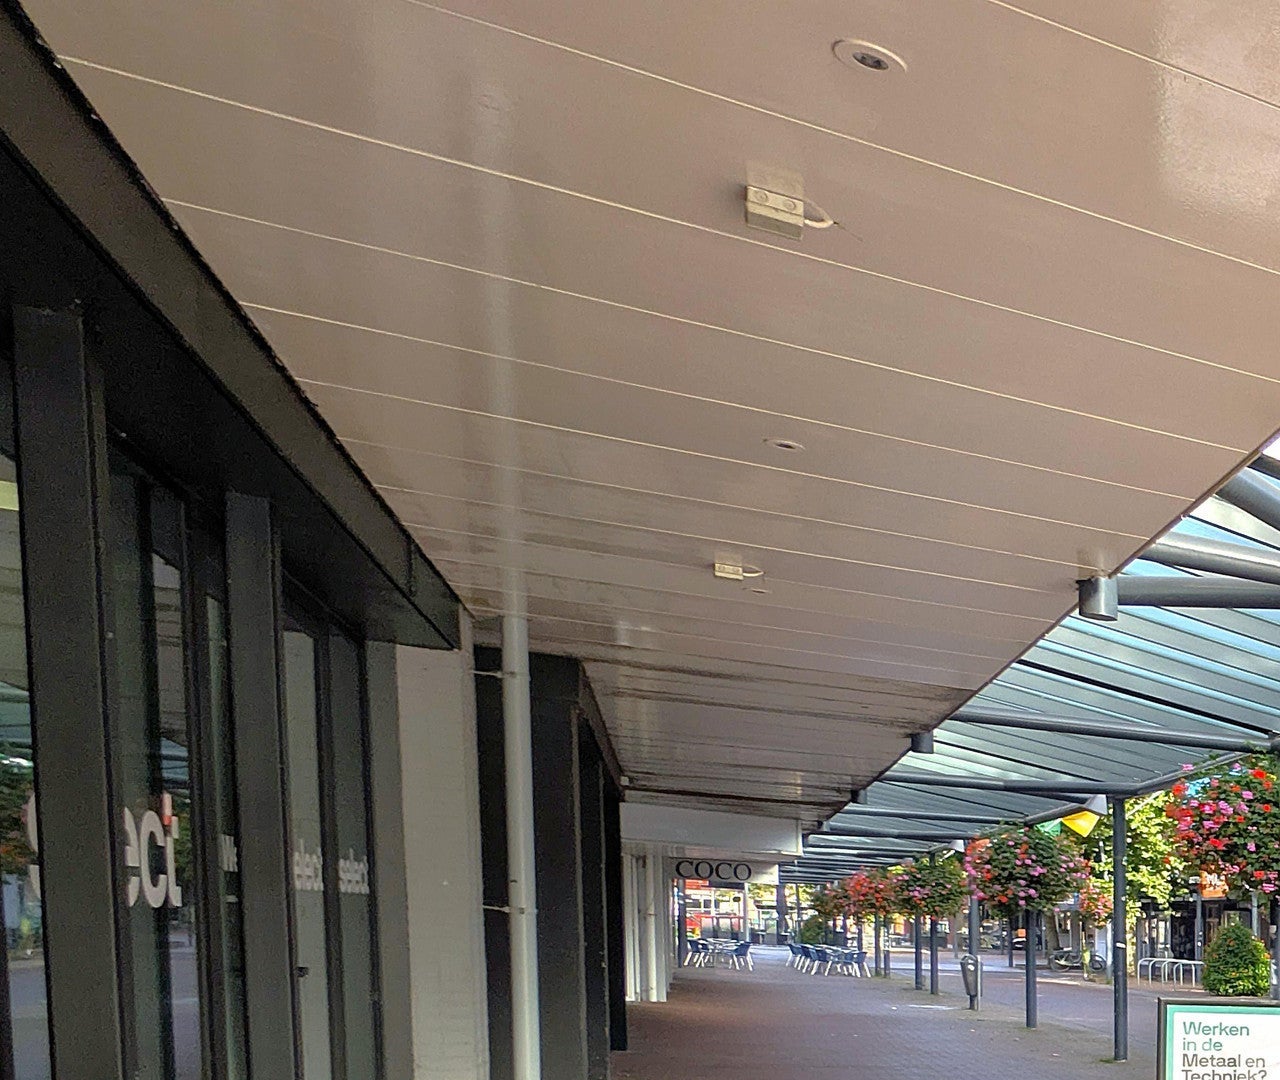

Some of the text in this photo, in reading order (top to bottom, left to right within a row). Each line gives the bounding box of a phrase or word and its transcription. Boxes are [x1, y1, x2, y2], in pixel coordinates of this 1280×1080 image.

[294, 838, 324, 892] elect
[338, 848, 370, 895] select
[675, 860, 752, 881] COCO
[1182, 1021, 1250, 1036] Werken
[1182, 1038, 1223, 1051] in de
[1182, 1053, 1266, 1068] Metaal en
